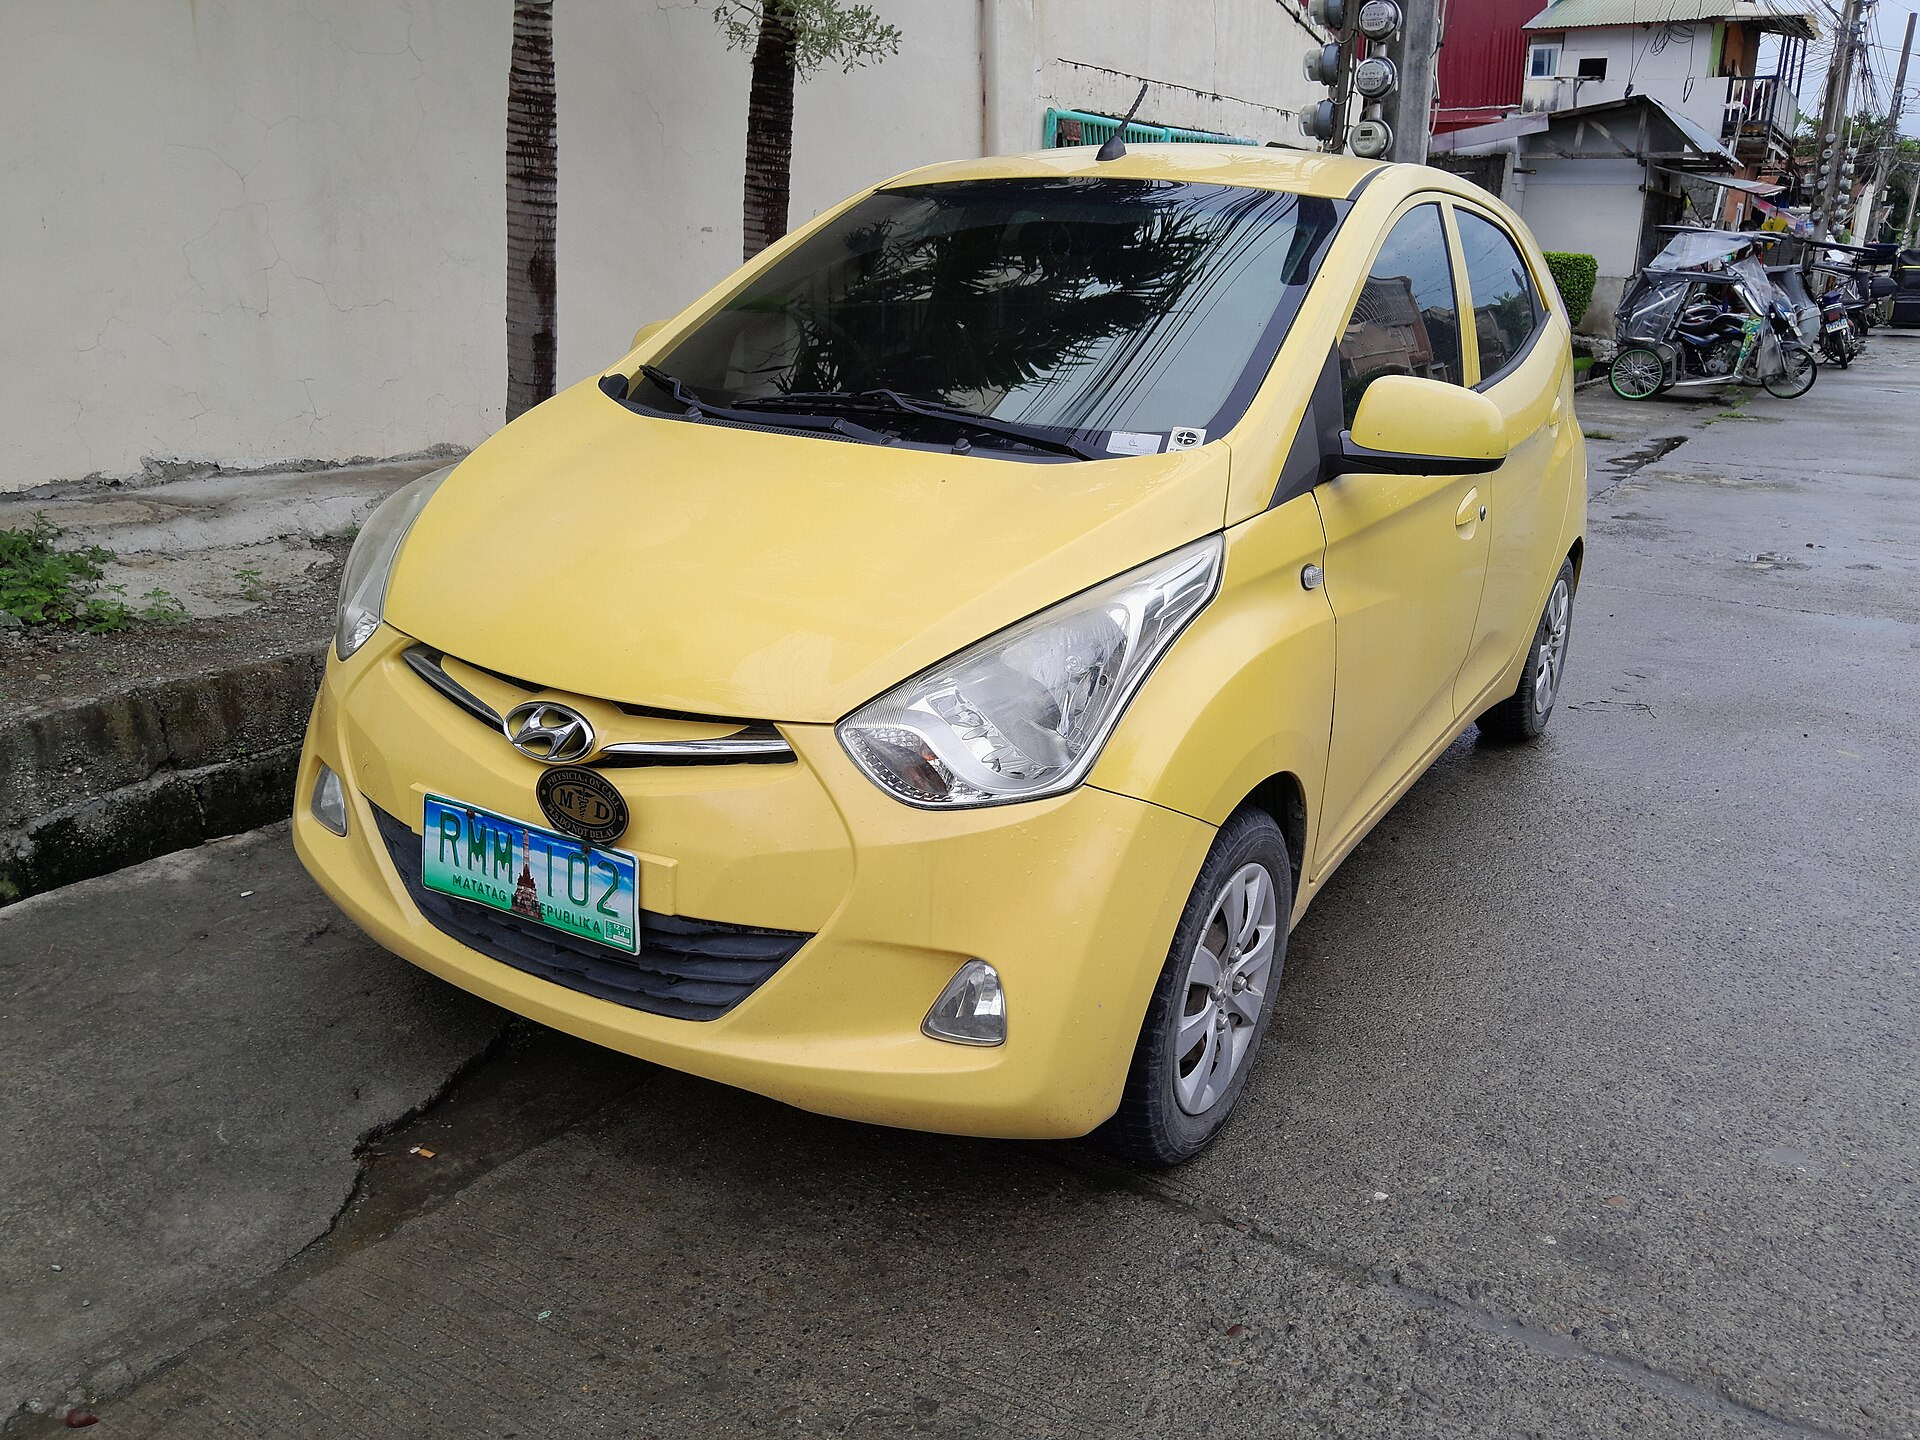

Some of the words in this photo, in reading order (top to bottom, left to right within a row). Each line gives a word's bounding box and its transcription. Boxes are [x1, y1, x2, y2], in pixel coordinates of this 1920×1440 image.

[559, 788, 574, 809] M
[594, 800, 610, 820] D
[589, 777, 601, 789] ON
[601, 785, 620, 809] CALL
[571, 824, 588, 837] NOT
[589, 827, 615, 839] DELAY
[439, 810, 514, 885] RMM
[546, 844, 620, 918] 102
[452, 874, 507, 902] MATATAG
